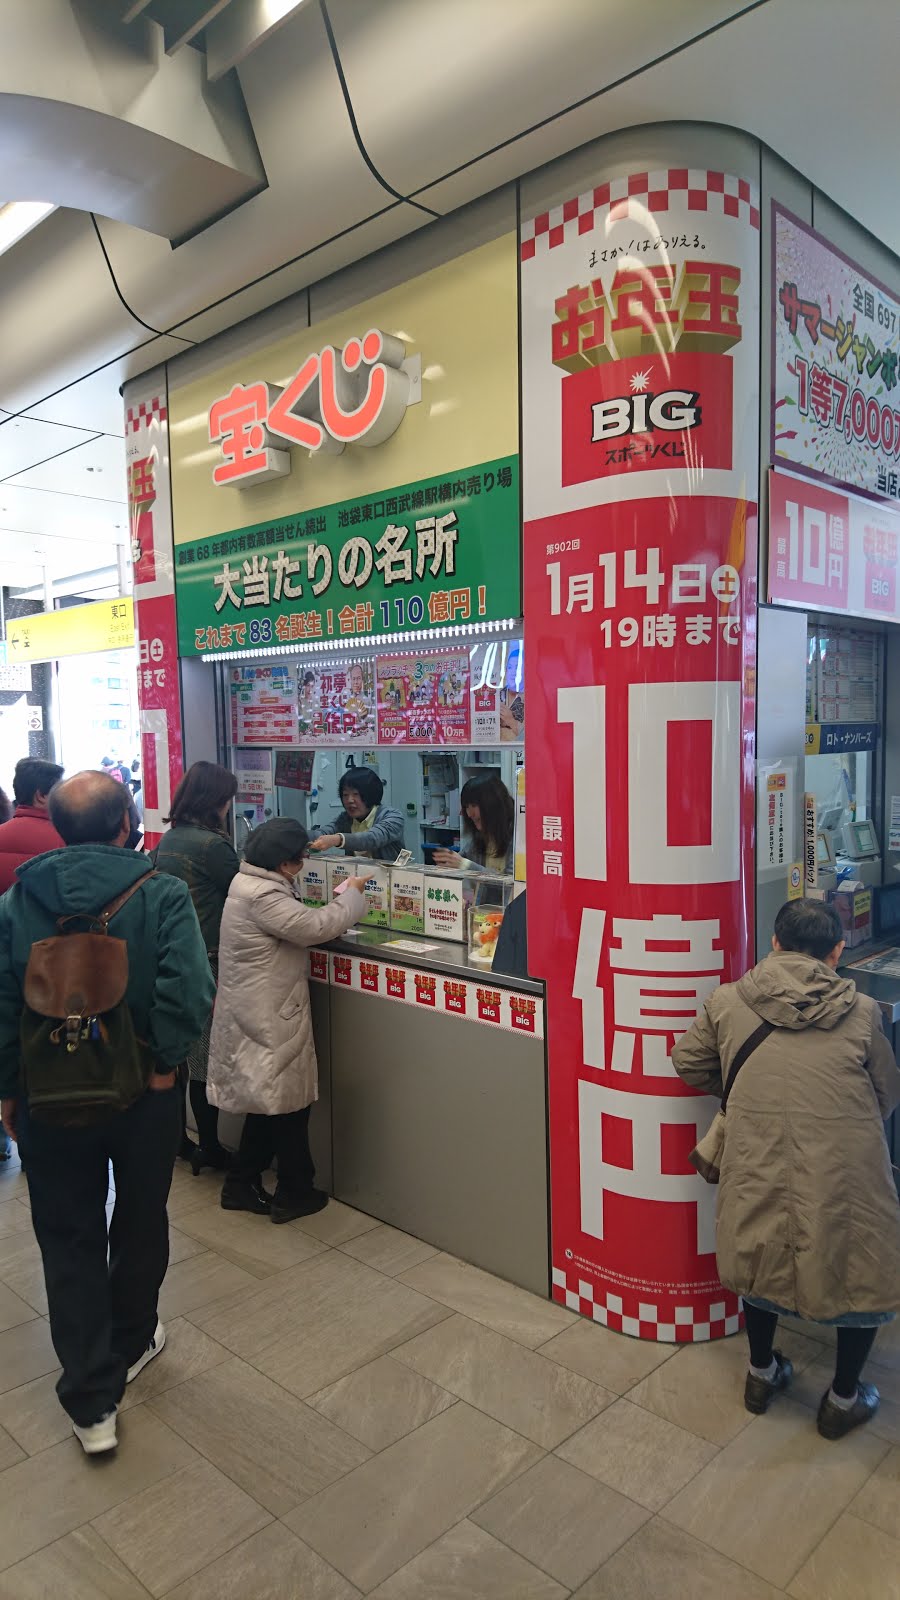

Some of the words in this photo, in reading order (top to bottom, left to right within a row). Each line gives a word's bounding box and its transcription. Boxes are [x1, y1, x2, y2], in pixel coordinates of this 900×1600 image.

[552, 260, 742, 366] お年玉
[208, 328, 388, 486] 宝くじ
[591, 389, 702, 444] BIG
[546, 538, 581, 556] 第902回
[213, 511, 458, 613] 大当たりの名所
[599, 613, 742, 649] 19時まで
[478, 699, 492, 708] BIG
[826, 730, 873, 747] ロト・ナンバーズ
[542, 815, 563, 877] 最高
[313, 967, 324, 975] BIG
[363, 979, 375, 987] BIG
[389, 985, 402, 993] BIG
[419, 992, 432, 1001] BIG
[448, 1000, 462, 1009] BIG
[482, 1007, 496, 1017] BIG
[515, 1015, 530, 1026] BIG
